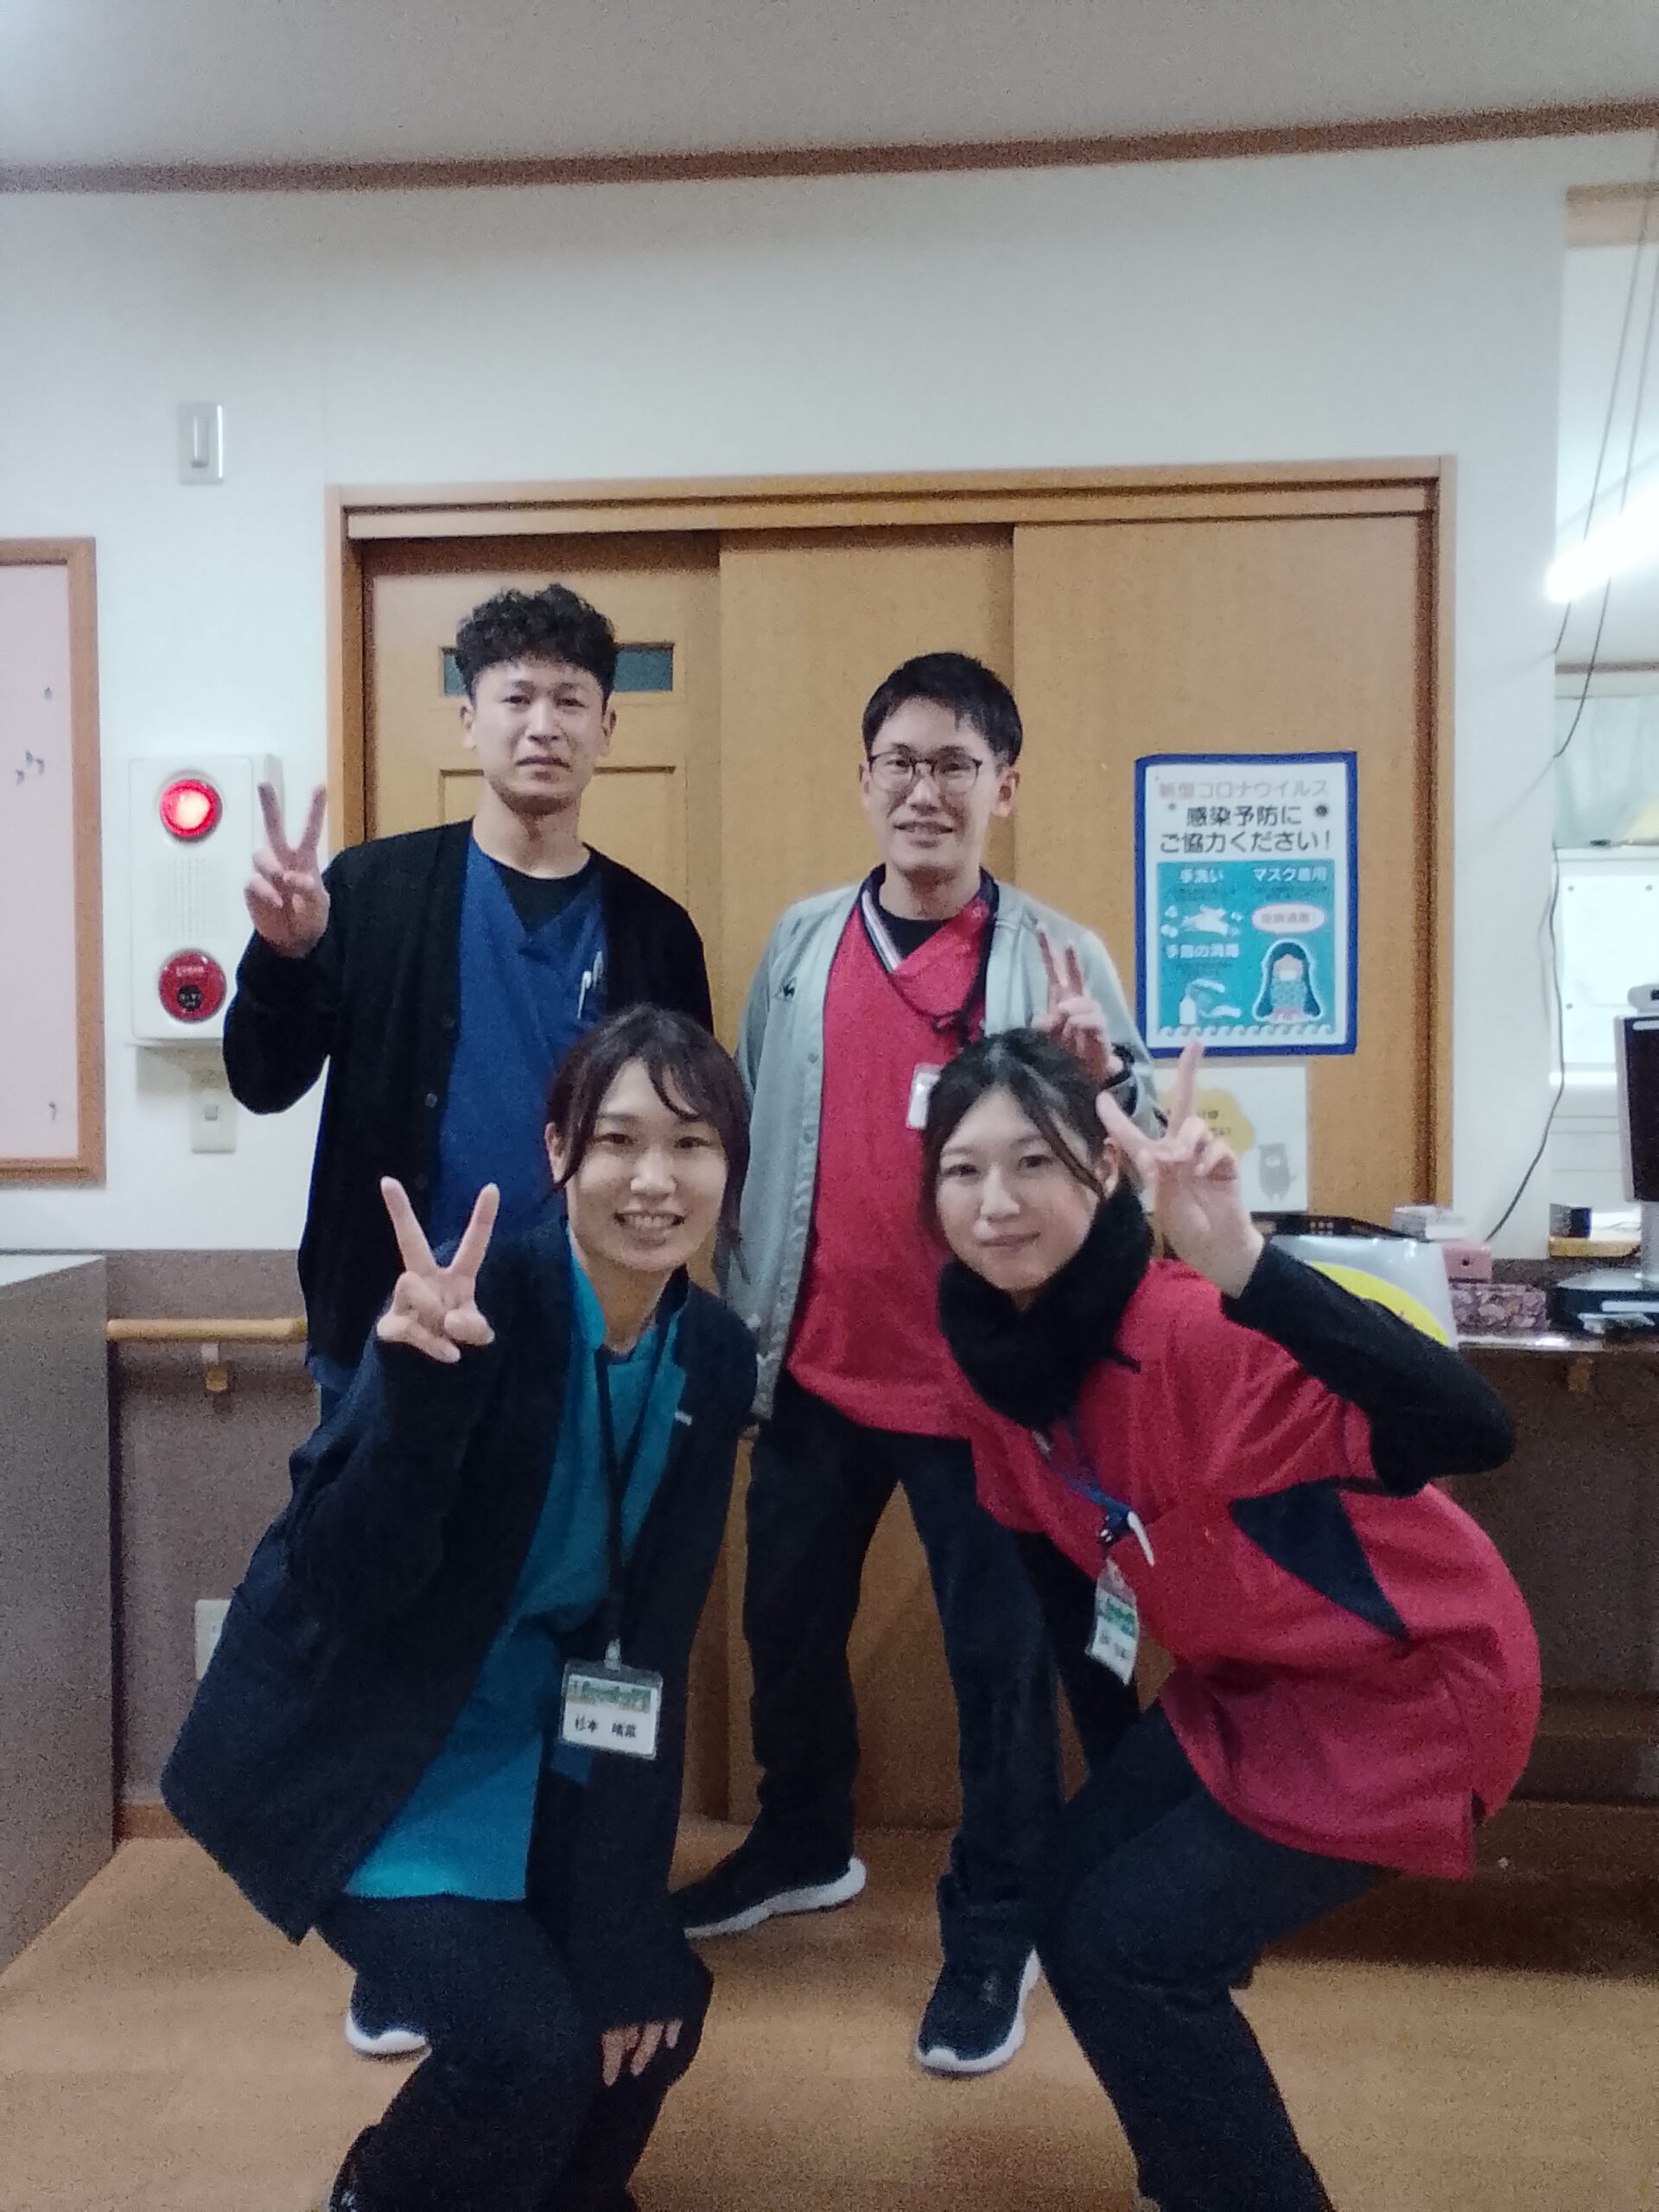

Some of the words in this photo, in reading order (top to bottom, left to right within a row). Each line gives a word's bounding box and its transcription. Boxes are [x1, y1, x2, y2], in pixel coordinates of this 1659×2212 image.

[1159, 780, 1330, 799] 新型コロナウイルス
[1186, 804, 1302, 827] 感染予防に
[1160, 830, 1331, 854] ご協力ください！
[1180, 868, 1224, 884] 手洗い
[1253, 867, 1327, 882] マスク着用
